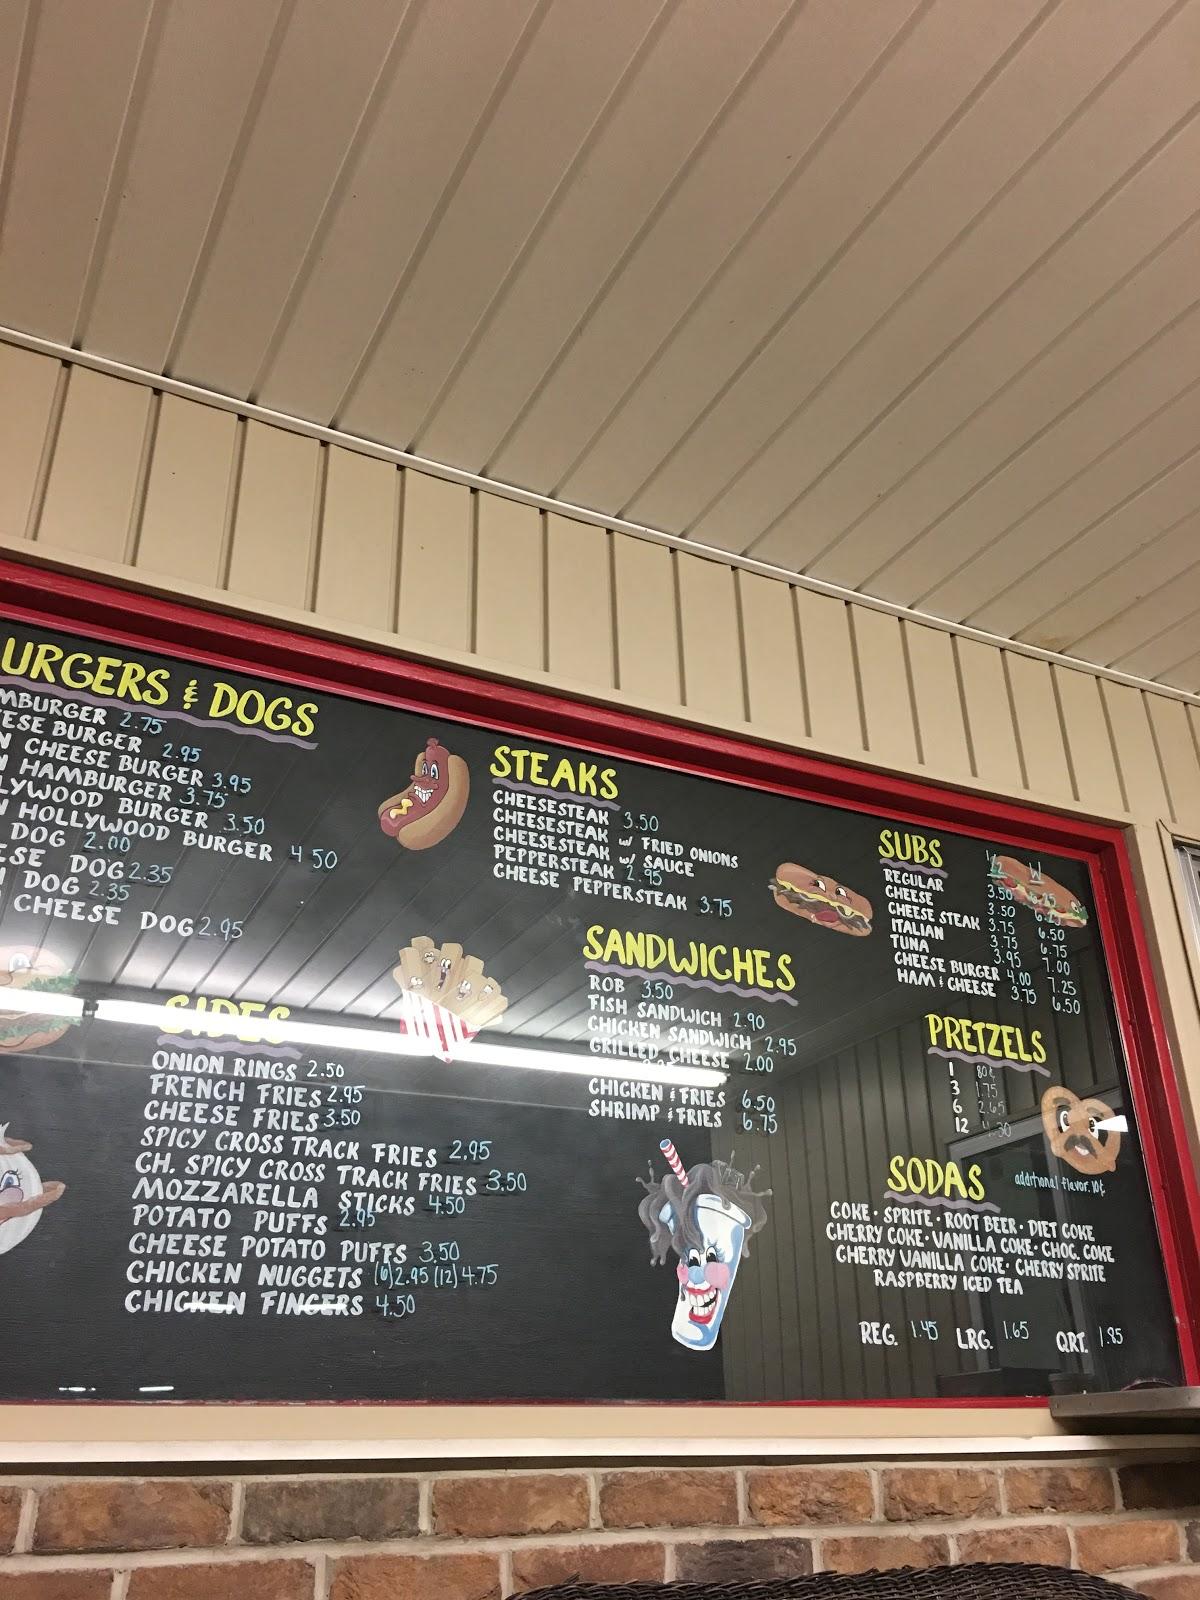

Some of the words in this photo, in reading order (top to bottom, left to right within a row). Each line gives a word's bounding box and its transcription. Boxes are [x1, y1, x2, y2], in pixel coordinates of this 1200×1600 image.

[1, 637, 170, 705] URGERS
[183, 680, 198, 709] &
[209, 683, 318, 736] DOGS
[0, 688, 107, 725] MBURGER
[120, 712, 167, 734] 2.75
[52, 720, 142, 753] BURGER
[162, 743, 201, 762] 2.95
[19, 758, 172, 801] HAMBURGER
[180, 788, 228, 808] 3.75
[25, 737, 111, 769] CHEESE
[119, 755, 203, 787] BURGER
[212, 772, 251, 793] 3.95
[490, 745, 620, 800] STEAKS
[118, 798, 208, 829] BURGER
[224, 813, 264, 834] 3.50
[493, 790, 610, 825] CHEESESTEAK
[623, 811, 659, 832] 3.50
[11, 822, 65, 847] DOG
[84, 832, 130, 852] 2.00
[19, 802, 170, 840] HOLLYWOOD
[183, 830, 273, 861] BURGER
[493, 807, 609, 843] CHEESESTEAK
[641, 837, 684, 856] FRIED
[689, 847, 739, 869] ONIONS
[878, 829, 944, 868] SUBS
[70, 854, 124, 879] DOG
[128, 862, 173, 883] 2.35
[493, 825, 610, 861] CHEESESTEAK
[642, 855, 695, 877] SAUCE
[493, 844, 615, 879] PEPPERSTEAK
[626, 864, 663, 886] 2.95
[24, 870, 79, 895] DOG
[89, 880, 130, 900] 2.35
[493, 862, 560, 889] CHEESE
[572, 876, 688, 911] PEPPERSTEAK
[699, 895, 733, 918] 3.75
[883, 868, 944, 892] REGULAR
[988, 884, 1012, 901] 3.50
[885, 884, 934, 907] CHEESE
[988, 902, 1016, 918] 3.50
[14, 894, 121, 925] CHEESE
[141, 911, 193, 936] DOG
[199, 917, 243, 939] 2.95
[888, 902, 935, 923] CHEESE
[939, 912, 981, 931] STEAK
[988, 918, 1015, 935] 3.75
[1038, 927, 1065, 941] 6.50
[890, 934, 929, 953] TUNA
[993, 950, 1021, 968] 3.95
[1042, 958, 1070, 975] 7.00
[891, 919, 944, 940] ITALIAN
[990, 935, 1018, 950] 3.75
[1040, 943, 1068, 957] 6.75
[582, 925, 797, 991] SANDWICHES
[894, 951, 945, 973] CHEESE
[951, 960, 1001, 982] BURGER
[1006, 969, 1031, 986] 4.00
[1047, 977, 1076, 995] 7.25
[588, 975, 625, 994] ROB
[641, 980, 674, 1000] 3.50
[897, 968, 936, 988] HAM
[947, 977, 997, 998] CHEESE
[1011, 986, 1037, 1005] 3.75
[1052, 998, 1081, 1014] 6.50
[587, 995, 628, 1015] FISH
[637, 1001, 722, 1028] SANDWICH
[733, 1012, 765, 1030] 2.90
[587, 1016, 661, 1040] CHICKEN
[668, 1025, 752, 1051] SANDWICH
[765, 1036, 796, 1056] 2.95
[589, 1037, 659, 1060] GRILLED
[669, 1046, 730, 1069] CHEESE
[743, 1052, 774, 1073] 2.00
[925, 1014, 1047, 1063] PRETZELS
[152, 1050, 224, 1075] ONION
[233, 1057, 297, 1082] RINGS
[306, 1060, 344, 1078] 2.50
[949, 1062, 954, 1077] 1
[150, 1073, 245, 1102] FRENCH
[257, 1083, 322, 1108] FRIES
[327, 1085, 366, 1104] 2.95
[589, 1077, 664, 1102] CHICKEN
[679, 1086, 726, 1108] FRIES
[741, 1089, 776, 1112] 6.50
[951, 1080, 960, 1095] 3
[976, 1081, 998, 1098] 1.75
[953, 1099, 962, 1114] 6
[978, 1101, 1005, 1115] 2.65
[144, 1100, 240, 1127] CHEESE
[253, 1108, 319, 1133] FRIES
[323, 1109, 361, 1128] 3.50
[588, 1099, 660, 1122] SHRIMP
[676, 1107, 722, 1128] FRIES
[742, 1113, 778, 1134] 6.75
[955, 1117, 970, 1134] 12
[140, 1127, 206, 1149] SPICY
[215, 1133, 283, 1154] CROSS
[291, 1139, 359, 1161] TRACK
[371, 1143, 437, 1167] FRIES
[448, 1140, 491, 1160] 2.95
[136, 1152, 176, 1174] CH.
[185, 1156, 251, 1179] SPICY
[260, 1161, 326, 1182] CROSS
[337, 1165, 408, 1190] TRACK
[419, 1172, 477, 1196] FRIES
[485, 1170, 527, 1191] 3.50
[887, 1155, 985, 1201] SODAS
[132, 1179, 318, 1209] MOZZARELLA
[339, 1190, 415, 1216] STICKS
[429, 1195, 466, 1216] 4.50
[132, 1204, 231, 1230] POTATO
[254, 1211, 328, 1235] PUFFS
[339, 1208, 376, 1228] 2.95
[830, 1201, 868, 1221] COKE
[884, 1206, 934, 1227] SPRITE
[945, 1212, 980, 1231] ROOT
[983, 1216, 1017, 1234] BEER
[1028, 1220, 1057, 1237] DIET
[1062, 1223, 1096, 1242] COKE
[129, 1233, 227, 1258] CHEESE
[241, 1236, 326, 1261] POTATO
[340, 1241, 407, 1264] PUFFS
[419, 1241, 460, 1262] 3.50
[826, 1223, 882, 1243] CHERRY
[887, 1227, 923, 1246] COKE
[932, 1231, 996, 1253] VANILLA
[1001, 1238, 1034, 1256] COKE
[1083, 1244, 1115, 1262] COKE
[126, 1261, 242, 1286] CHICKEN
[258, 1265, 362, 1289] NUGGETS
[394, 1265, 429, 1286] 2.95
[461, 1264, 498, 1285] 4.75
[836, 1245, 895, 1267] CHERRY
[900, 1250, 965, 1272] VANILLA
[971, 1255, 1005, 1274] COKE
[1016, 1259, 1064, 1279] CHERRY
[1067, 1263, 1106, 1282] SPRITE
[874, 1269, 957, 1290] RASPBERRY
[963, 1275, 992, 1293] ICED
[997, 1277, 1023, 1295] TEA
[125, 1290, 246, 1315] CHICKEN
[261, 1291, 364, 1316] FINGERS
[376, 1294, 415, 1317] 4.50
[859, 1321, 898, 1346] REG.
[911, 1320, 938, 1341] 1.45
[956, 1328, 993, 1350] LRG.
[1003, 1321, 1029, 1341] 1.65
[1056, 1332, 1088, 1354] QRT.
[1099, 1326, 1124, 1346] 1.85
